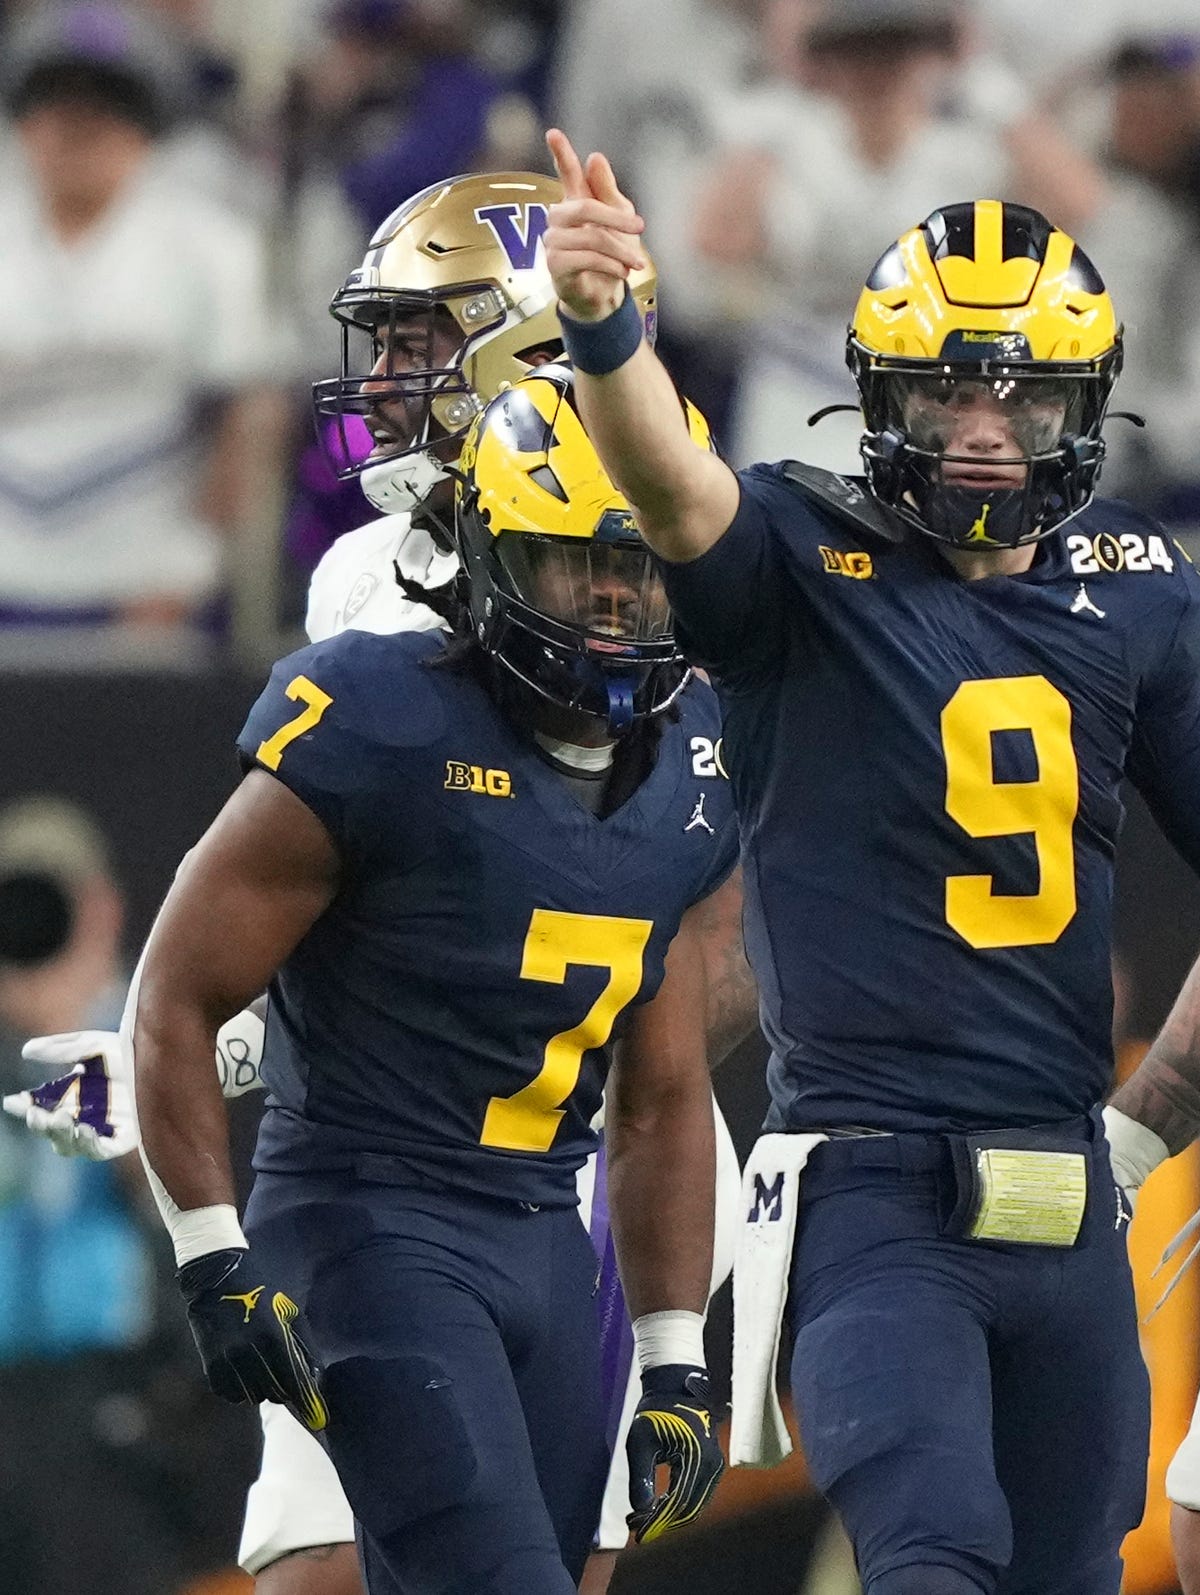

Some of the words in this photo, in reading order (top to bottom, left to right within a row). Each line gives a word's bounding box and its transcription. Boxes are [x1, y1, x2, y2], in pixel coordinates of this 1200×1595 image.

[1066, 532, 1174, 574] 2024
[256, 675, 334, 771] 7
[940, 674, 1079, 949] 9
[480, 908, 654, 1153] 7
[746, 1171, 785, 1223] M
